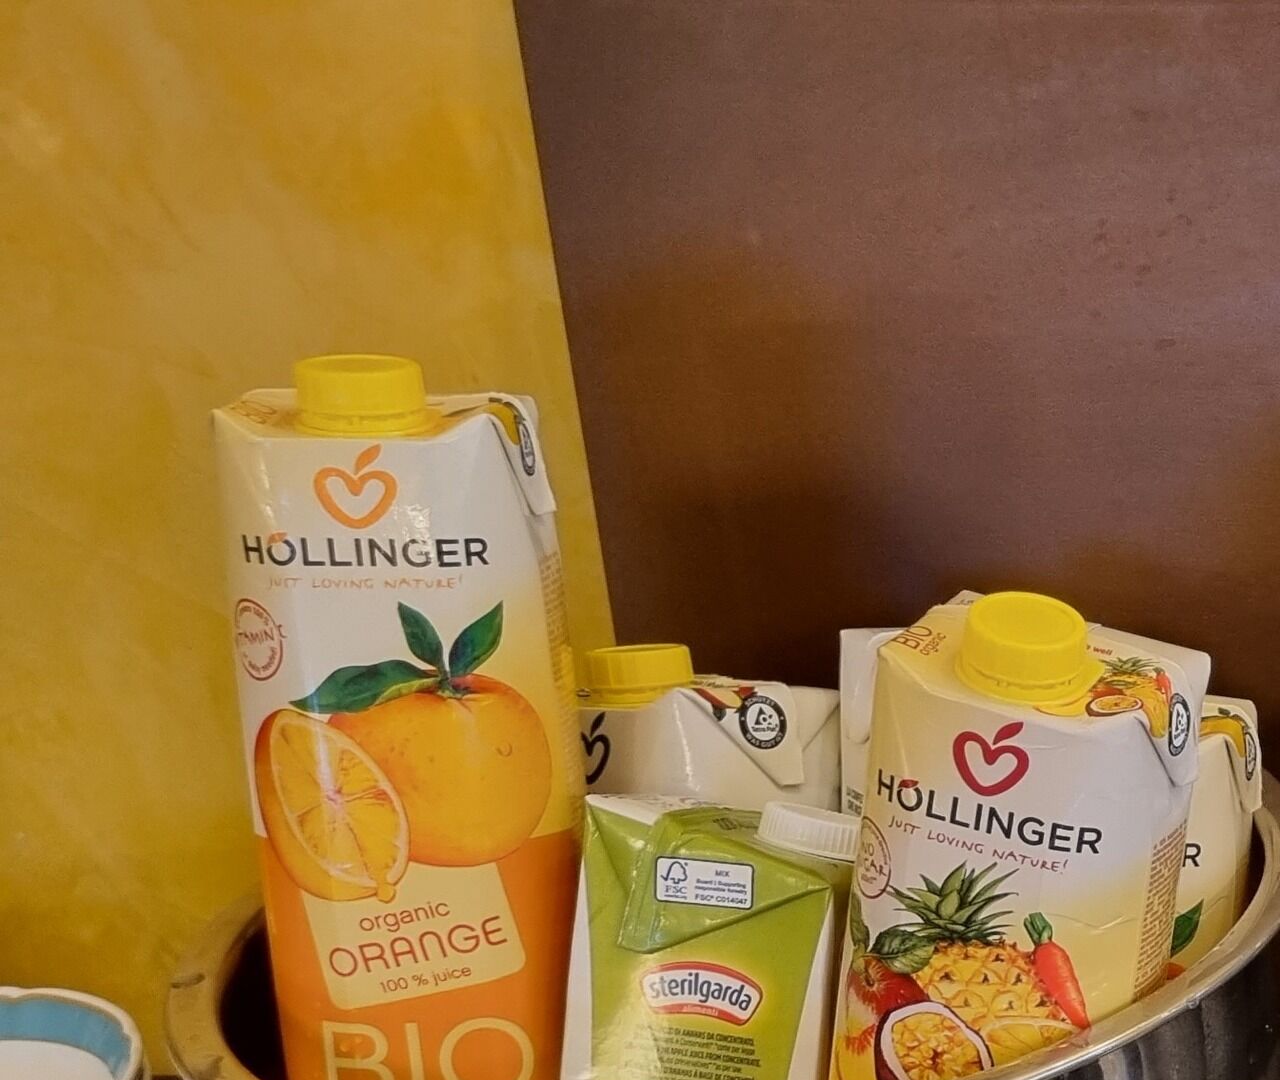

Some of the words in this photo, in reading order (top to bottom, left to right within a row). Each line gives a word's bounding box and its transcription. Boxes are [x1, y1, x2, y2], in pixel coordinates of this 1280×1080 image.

[312, 577, 375, 590] LOVING
[888, 815, 921, 836] JUST
[927, 829, 985, 855] LOVING
[992, 848, 1069, 873] NATURE!
[663, 885, 687, 894] FSC
[359, 901, 451, 932] organic
[328, 916, 508, 977] ORANGE
[379, 974, 409, 994] 100
[411, 972, 429, 987] %
[431, 964, 472, 988] juice
[648, 972, 752, 1012] sterilgarda
